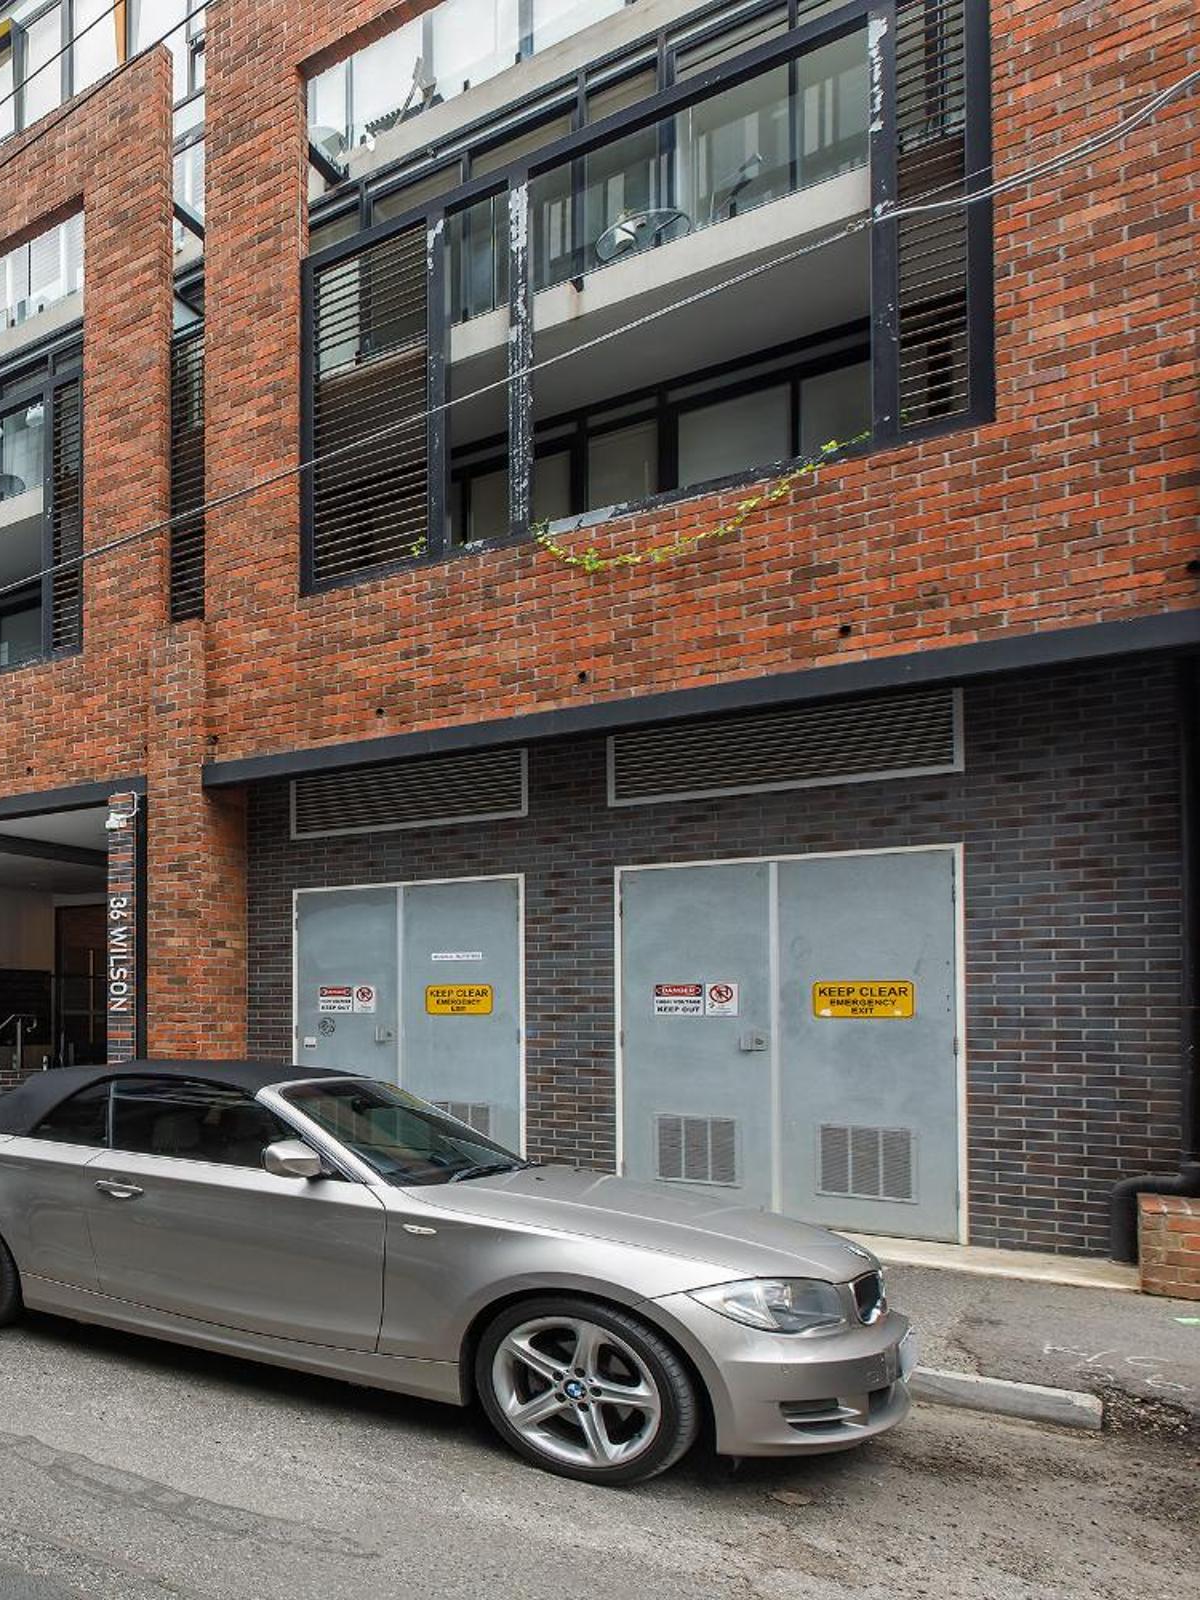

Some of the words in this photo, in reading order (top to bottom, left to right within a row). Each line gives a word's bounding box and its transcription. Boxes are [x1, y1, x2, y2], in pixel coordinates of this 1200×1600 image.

[110, 897, 128, 920] 36
[110, 926, 128, 1012] WILSON
[429, 988, 454, 997] KEEP
[456, 988, 489, 997] CLEAR
[818, 986, 855, 997] KEEP
[859, 986, 908, 997] CLEAR
[657, 1005, 679, 1013] KEEP
[681, 1005, 700, 1013] OUT
